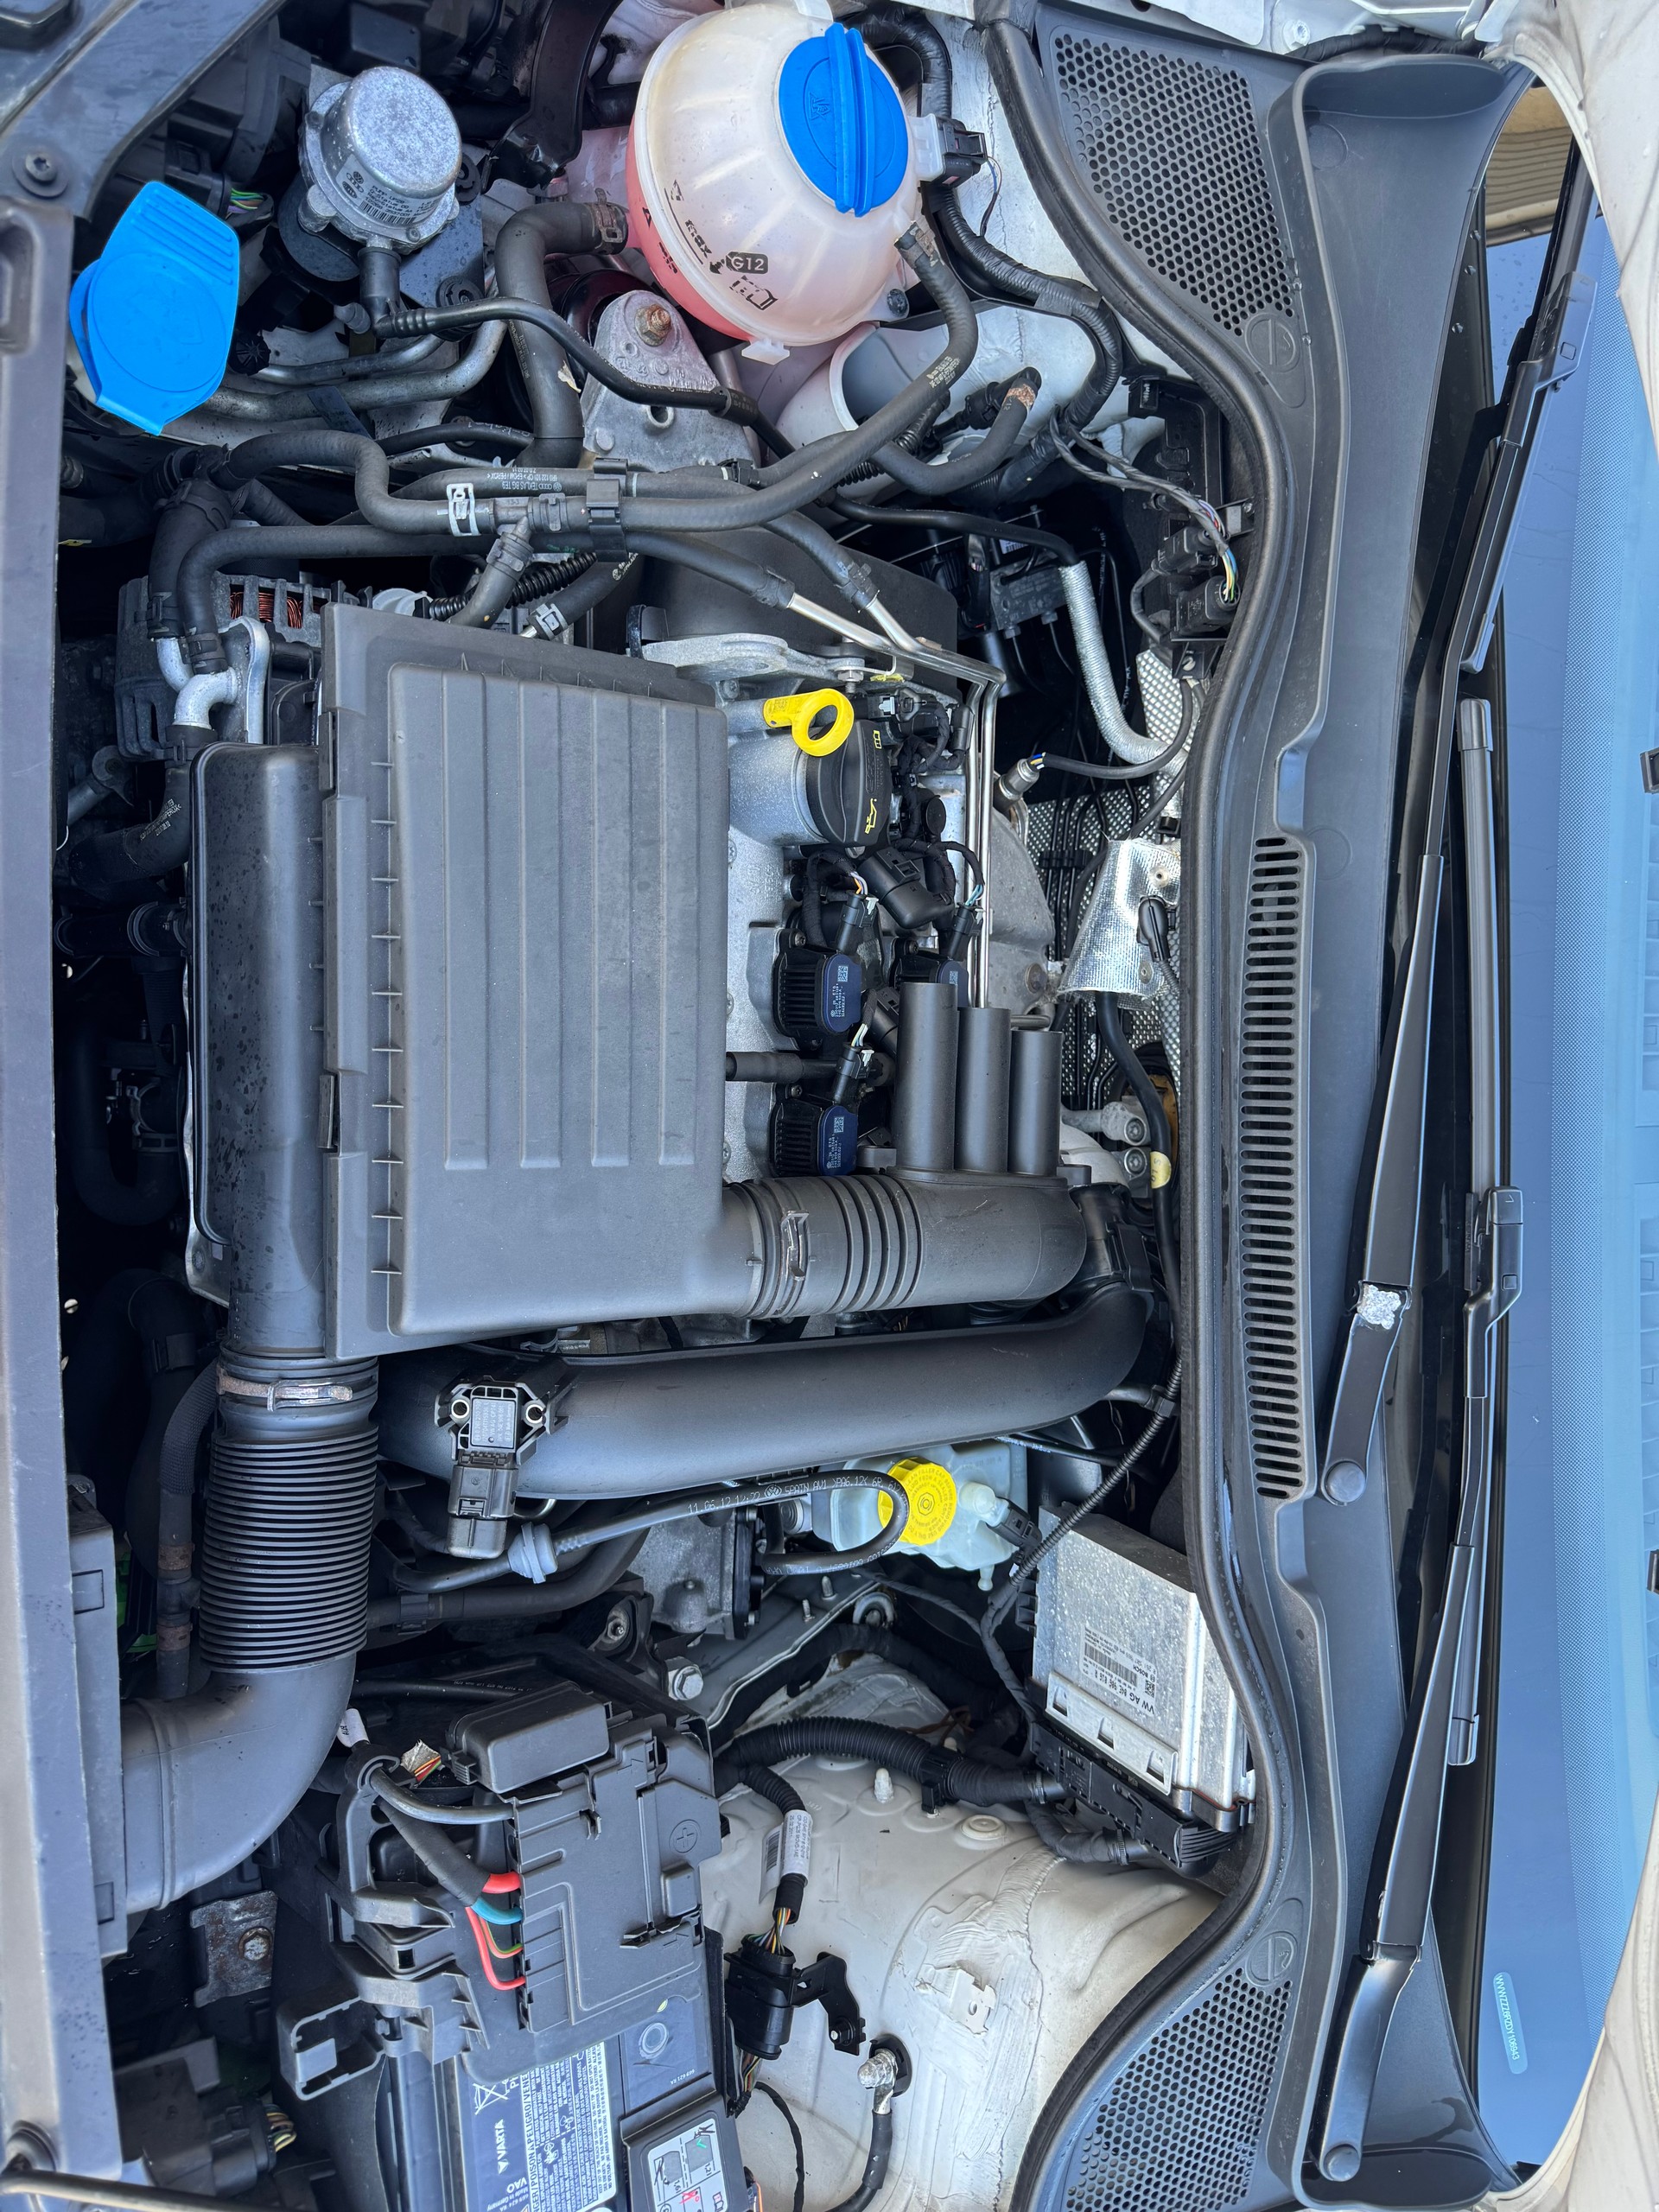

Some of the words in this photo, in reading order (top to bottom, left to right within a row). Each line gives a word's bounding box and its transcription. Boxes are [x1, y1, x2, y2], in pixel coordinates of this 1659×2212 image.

[731, 258, 764, 271] G12
[1129, 1691, 1140, 1705] AG
[1141, 1699, 1154, 1713] VW
[494, 2118, 506, 2160] VARTA
[506, 2177, 528, 2193] VAO
